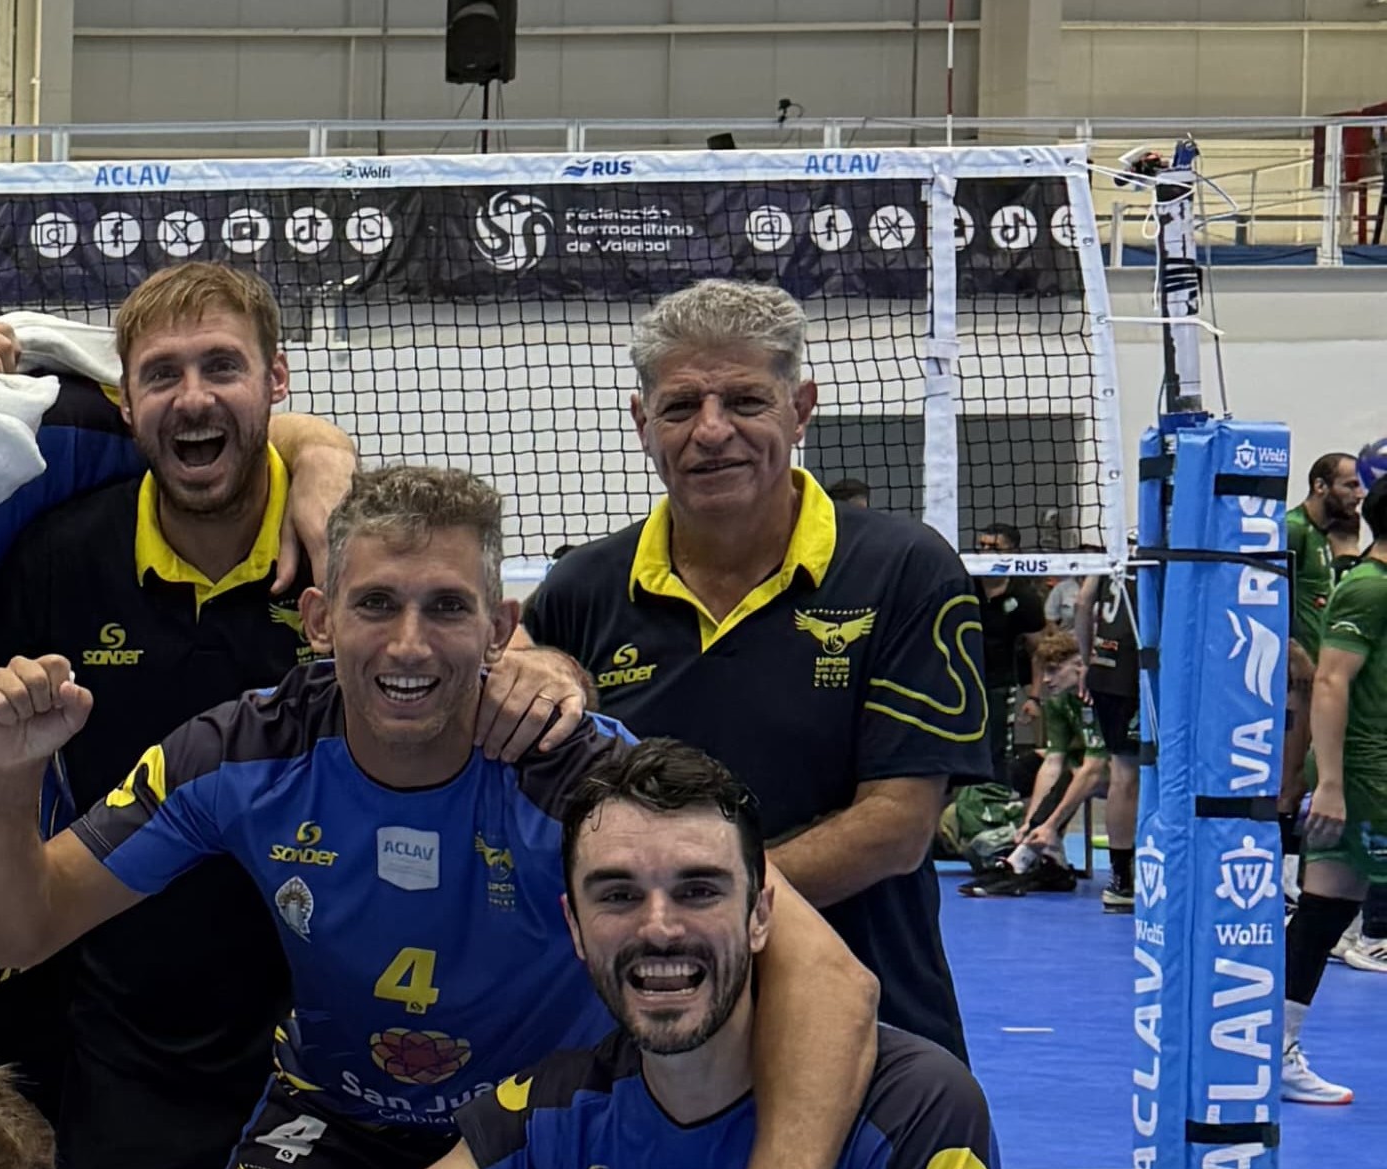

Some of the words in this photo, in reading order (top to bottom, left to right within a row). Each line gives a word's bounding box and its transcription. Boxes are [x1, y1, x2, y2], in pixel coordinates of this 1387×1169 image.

[358, 164, 392, 180] Wolfi
[592, 160, 633, 176] RUS
[805, 152, 881, 175] ACLAV
[94, 164, 172, 187] ACLAV
[1014, 559, 1049, 574] RUS
[382, 839, 435, 862] ACLAV
[1215, 922, 1274, 947] Wolfi
[372, 946, 440, 1015] 4
[341, 1069, 412, 1112] San
[254, 1113, 328, 1164] 4
